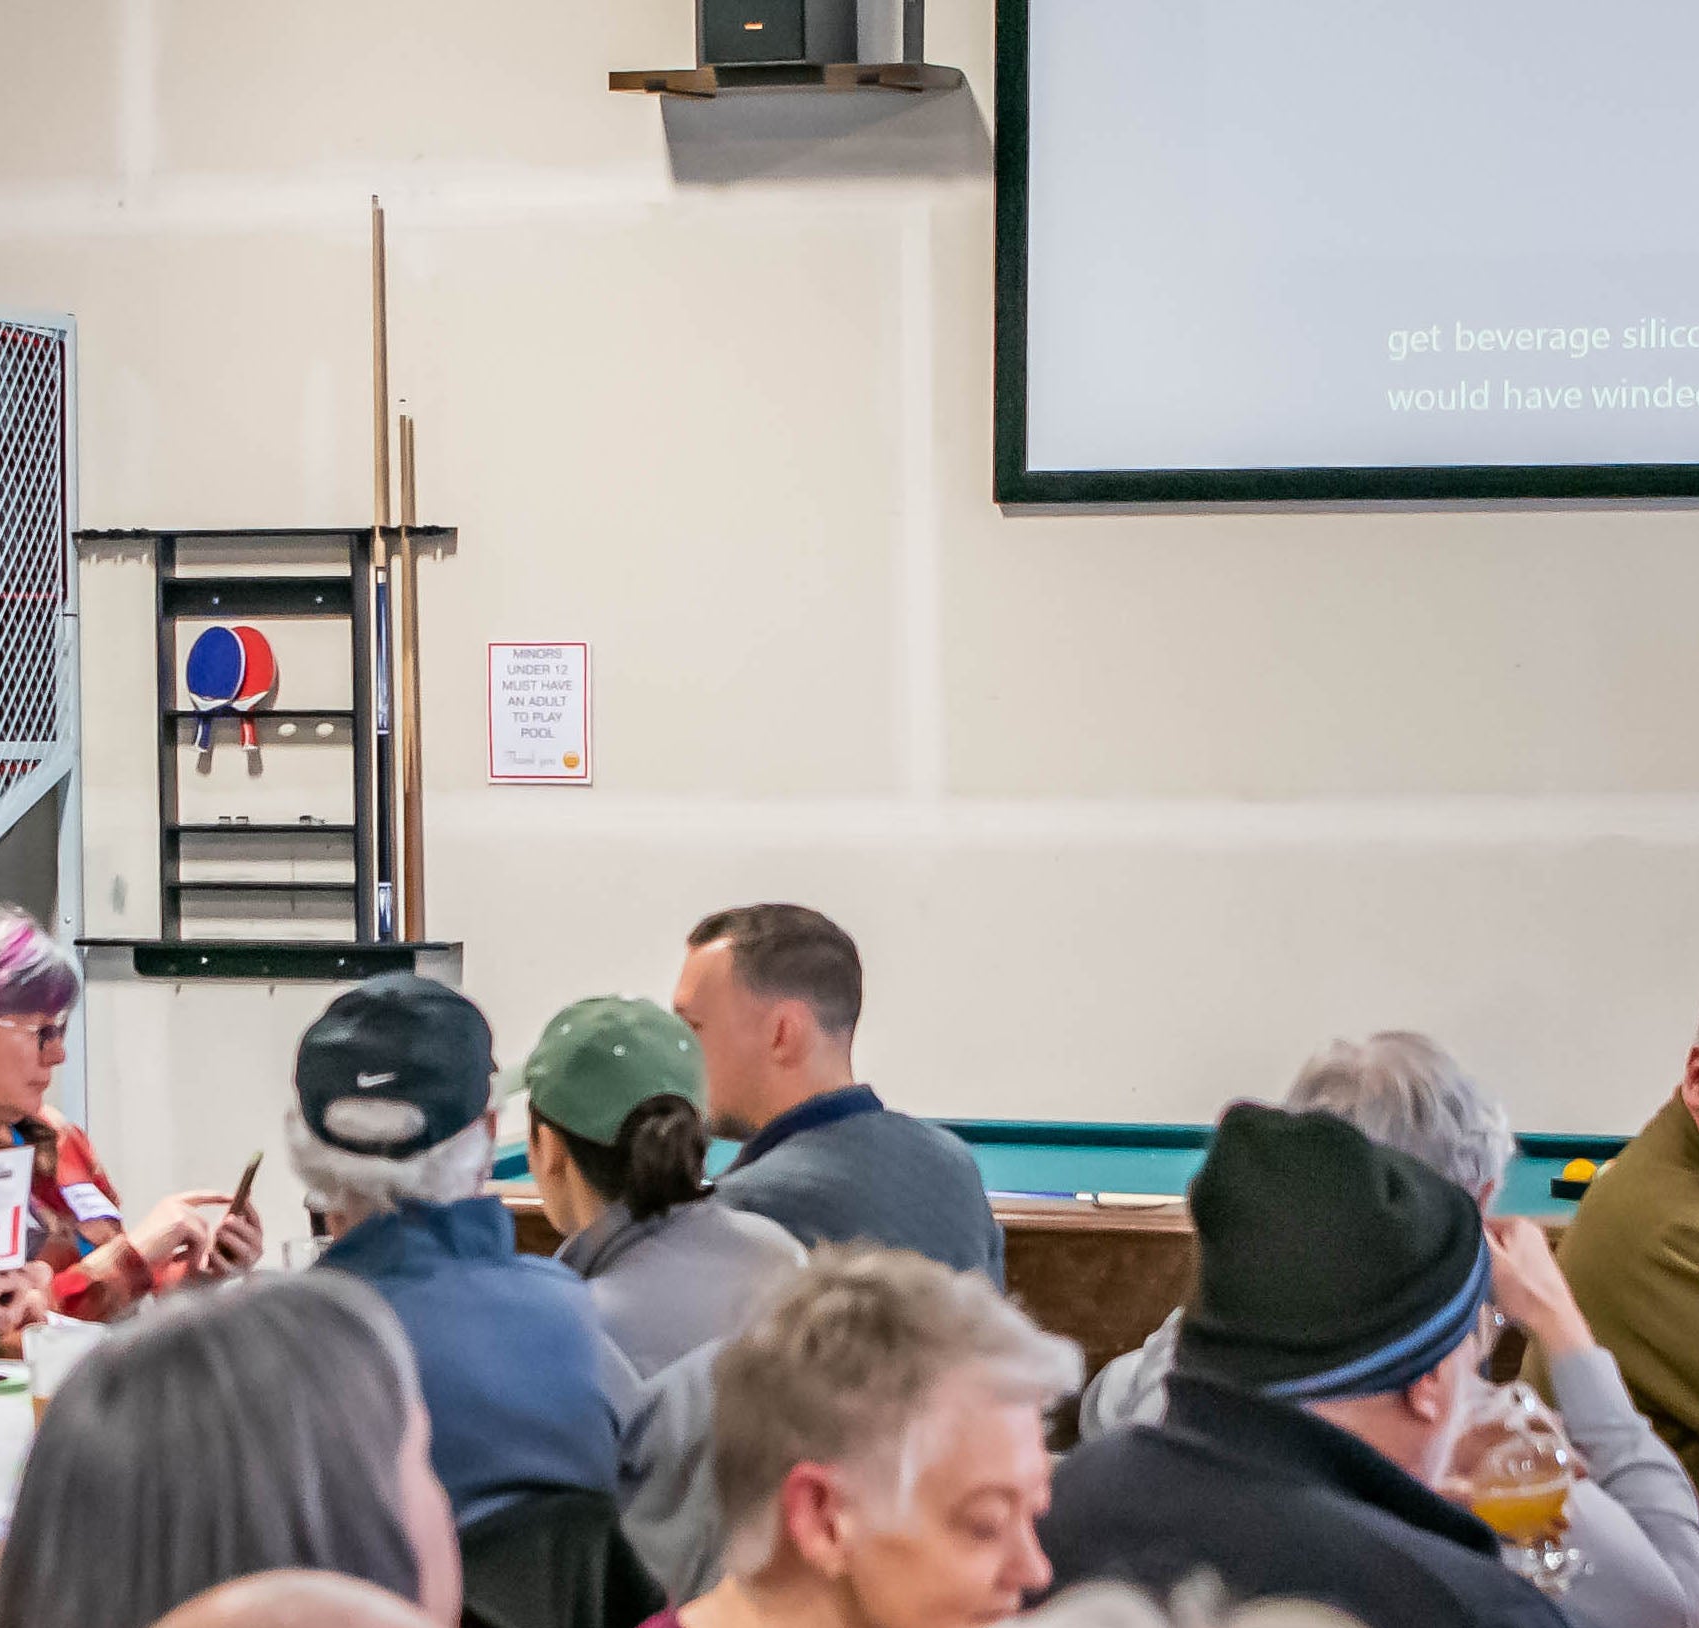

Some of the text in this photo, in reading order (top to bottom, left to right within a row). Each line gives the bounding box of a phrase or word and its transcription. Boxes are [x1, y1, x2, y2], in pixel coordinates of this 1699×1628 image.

[1388, 324, 1441, 361] get
[1455, 320, 1611, 359] beverage
[1387, 380, 1490, 412] would
[1503, 378, 1583, 411] have
[512, 648, 563, 660] MINORS
[506, 664, 569, 676] UNDER 12
[502, 680, 573, 692] MUST HAVE
[507, 696, 567, 707] AN ADULT
[512, 711, 563, 723] TO PLAY
[520, 727, 556, 739] POOL
